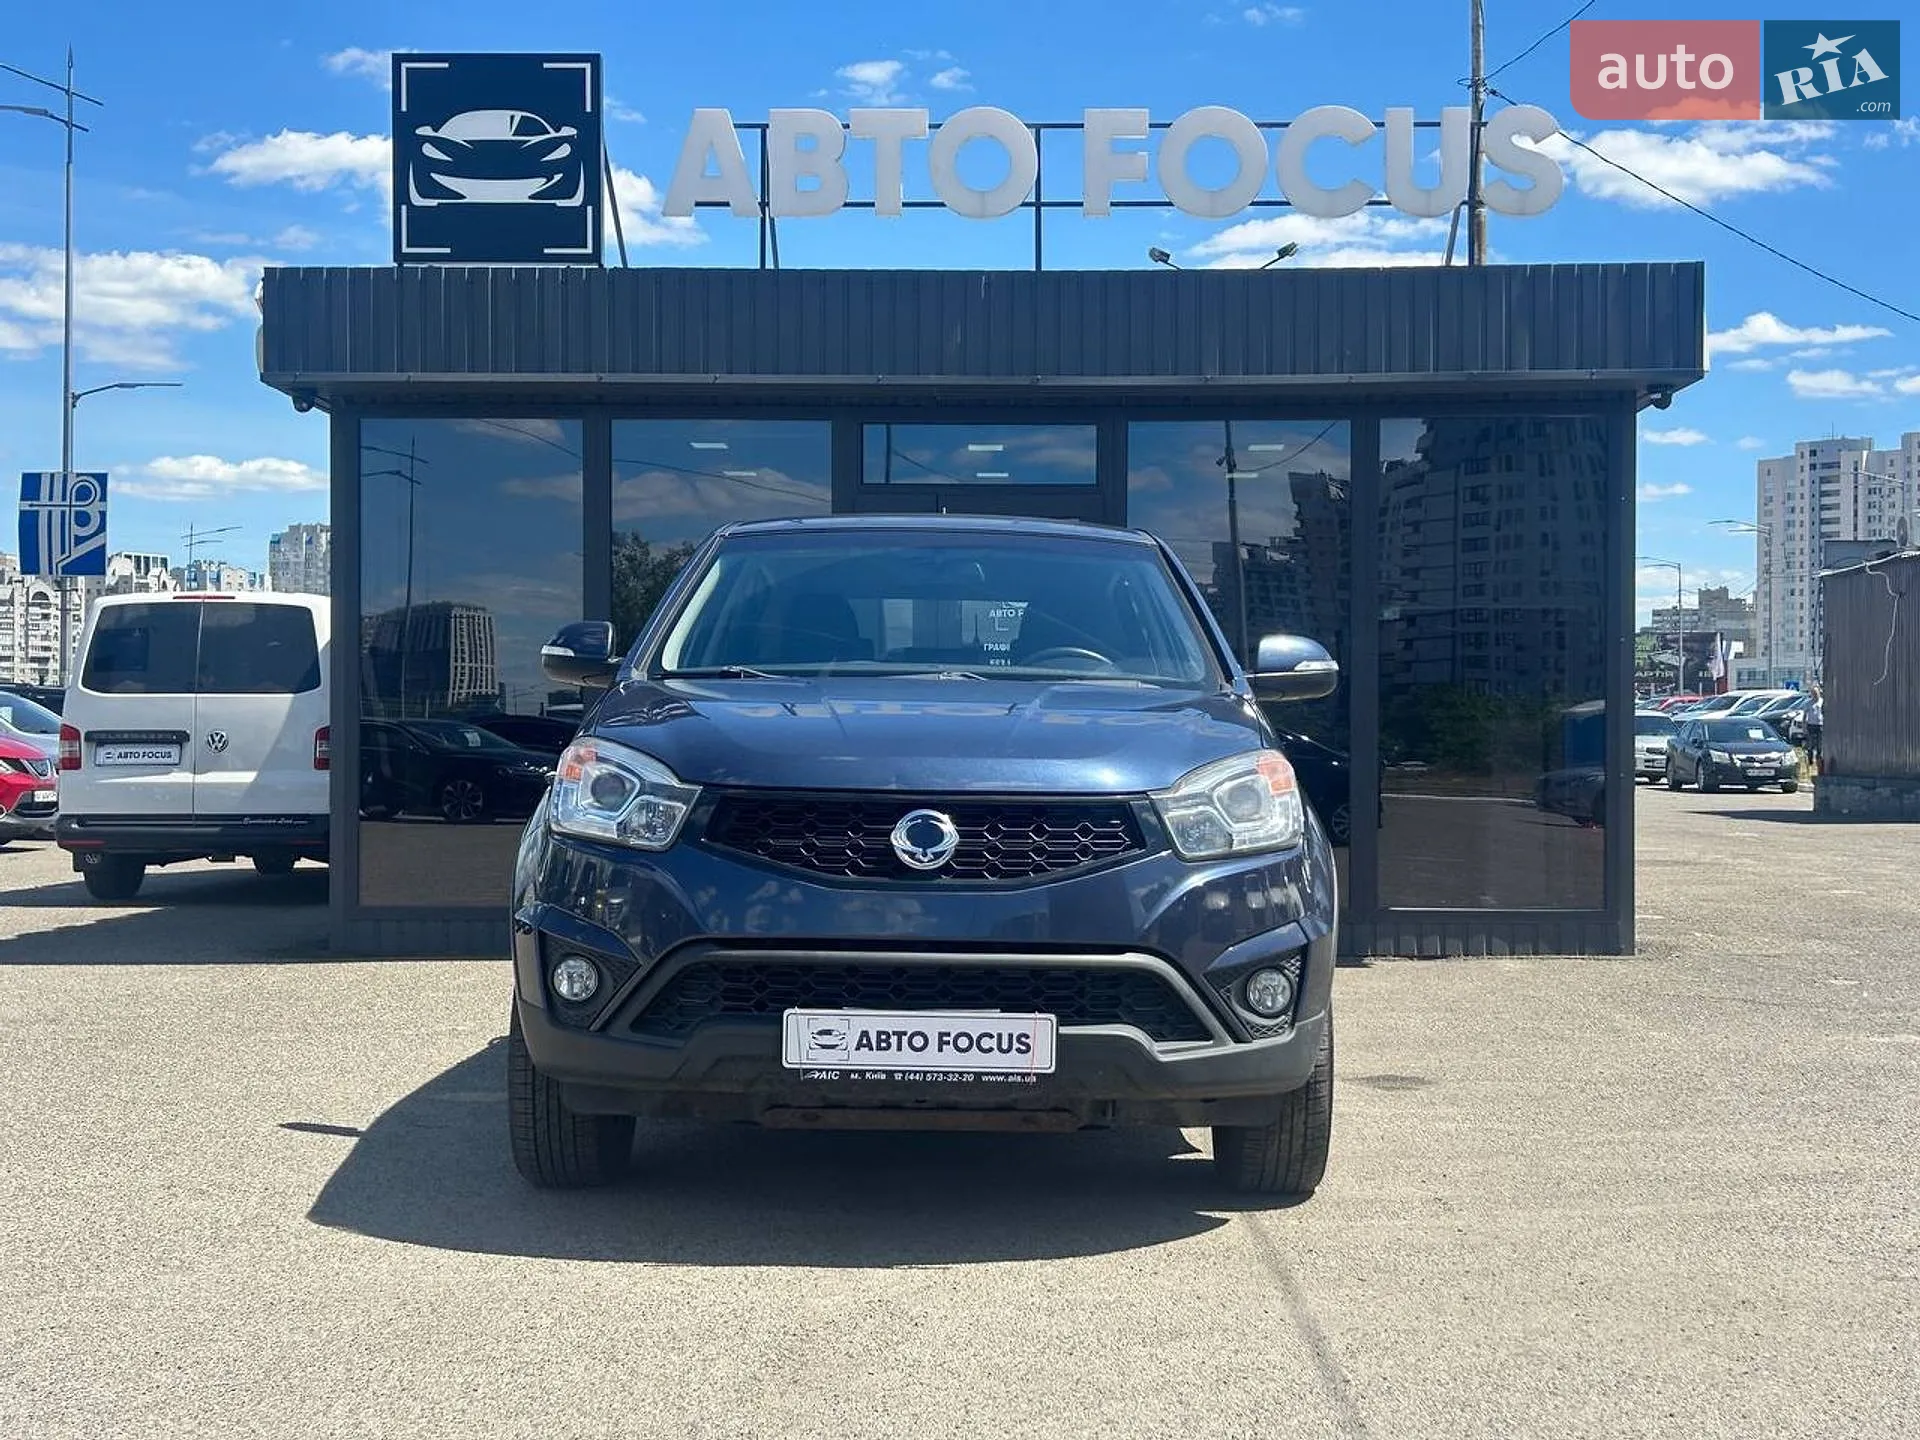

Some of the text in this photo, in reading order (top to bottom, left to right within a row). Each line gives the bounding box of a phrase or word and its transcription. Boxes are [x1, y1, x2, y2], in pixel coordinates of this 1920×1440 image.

[662, 105, 1564, 219] АВТО FOCUS
[855, 1030, 1032, 1054] АВТО FOCUS
